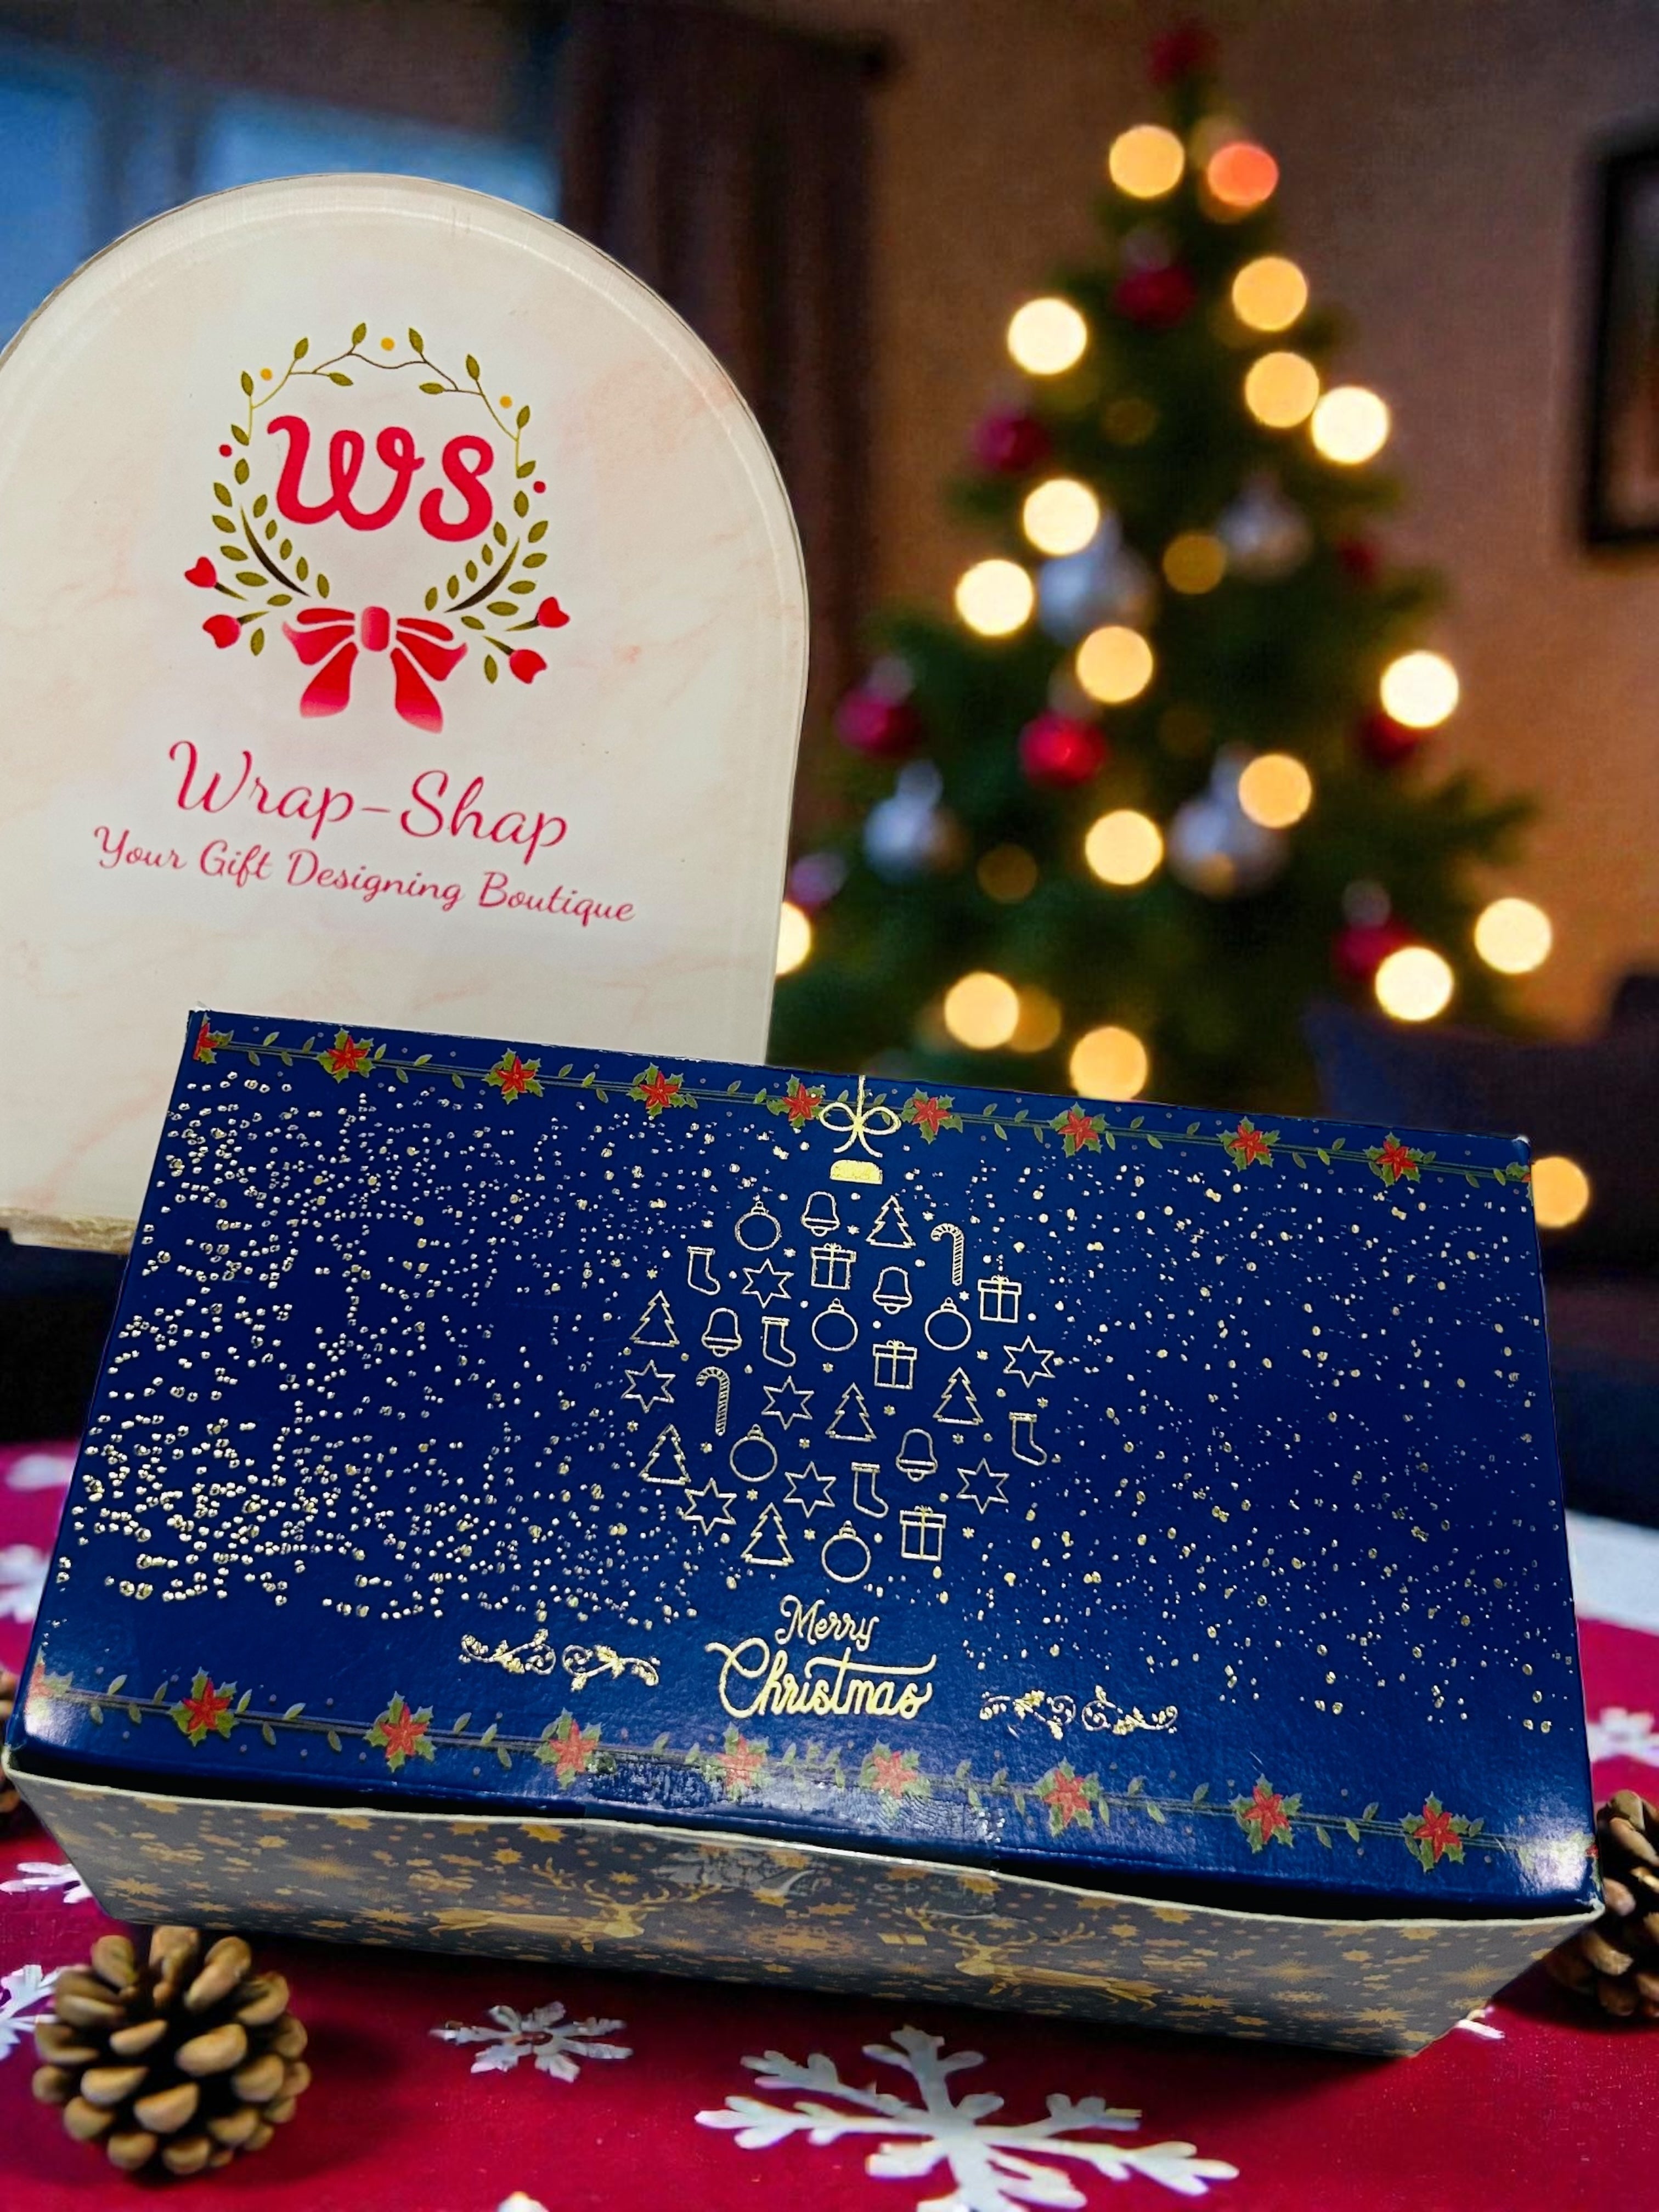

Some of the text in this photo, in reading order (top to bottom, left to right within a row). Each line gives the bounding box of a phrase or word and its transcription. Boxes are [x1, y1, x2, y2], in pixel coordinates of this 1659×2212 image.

[168, 740, 568, 864] Wrap-Shap
[94, 826, 636, 927] Your Gift Designing Boutique
[775, 1594, 879, 1651] Merry
[704, 1637, 938, 1719] Christmas
